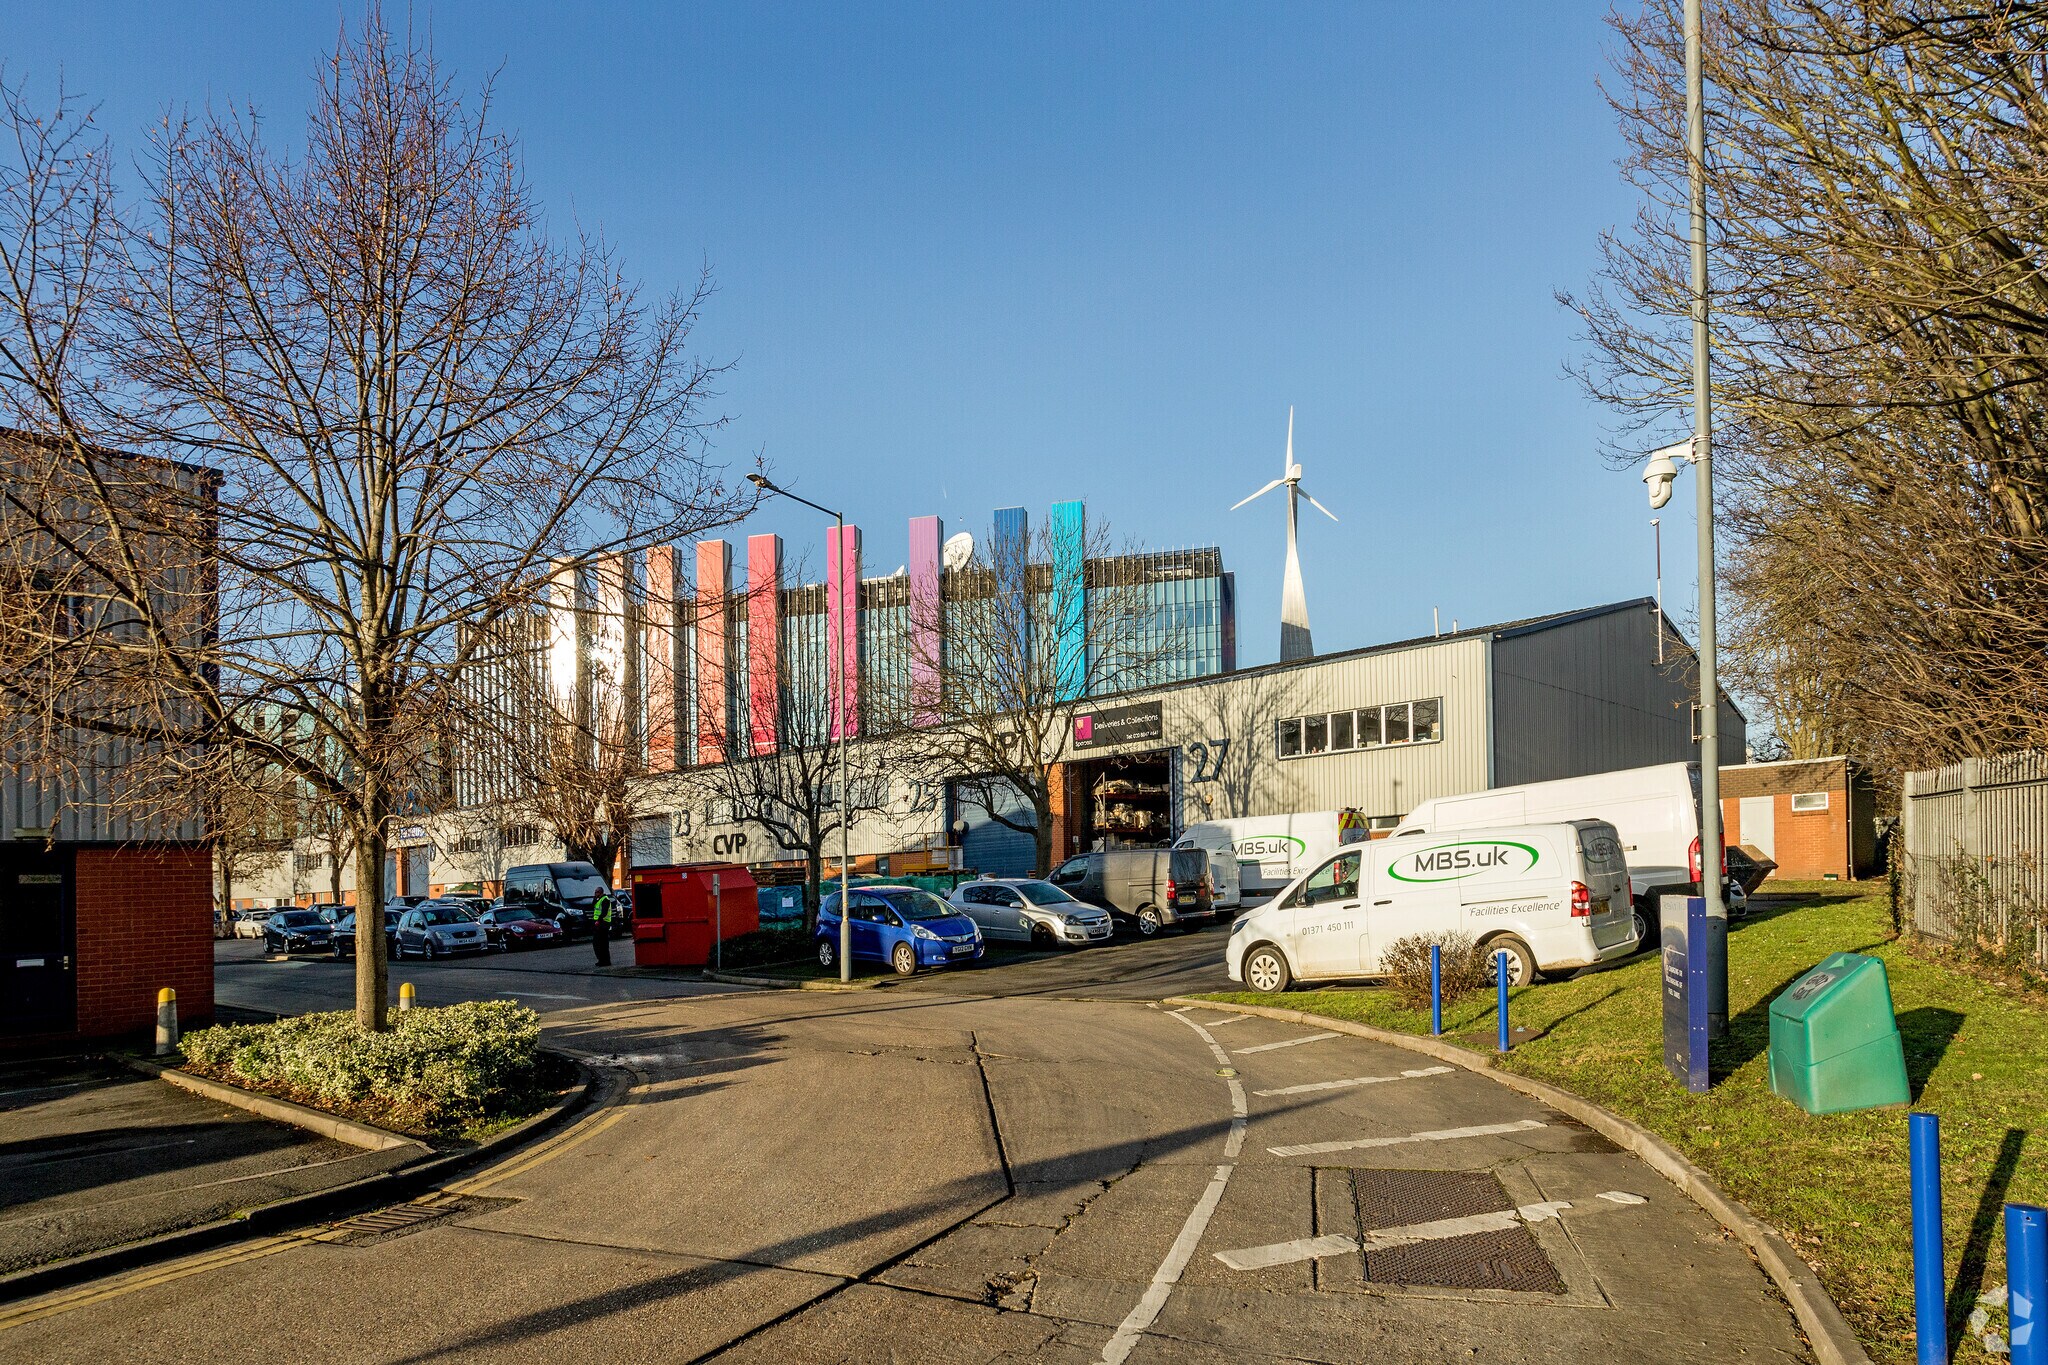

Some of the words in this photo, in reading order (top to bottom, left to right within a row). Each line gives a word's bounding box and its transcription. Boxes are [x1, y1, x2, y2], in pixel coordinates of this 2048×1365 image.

[1094, 719, 1120, 730] Deliveries
[1121, 718, 1126, 726] &
[1126, 714, 1159, 725] Collections
[1189, 738, 1231, 783] 27
[673, 810, 691, 837] 23
[713, 833, 748, 855] CVP
[1232, 839, 1288, 856] MBS.uk
[1415, 846, 1509, 872] MBS.uk
[1302, 925, 1323, 936] 01371
[1327, 922, 1342, 932] 450
[1344, 920, 1354, 930] 111
